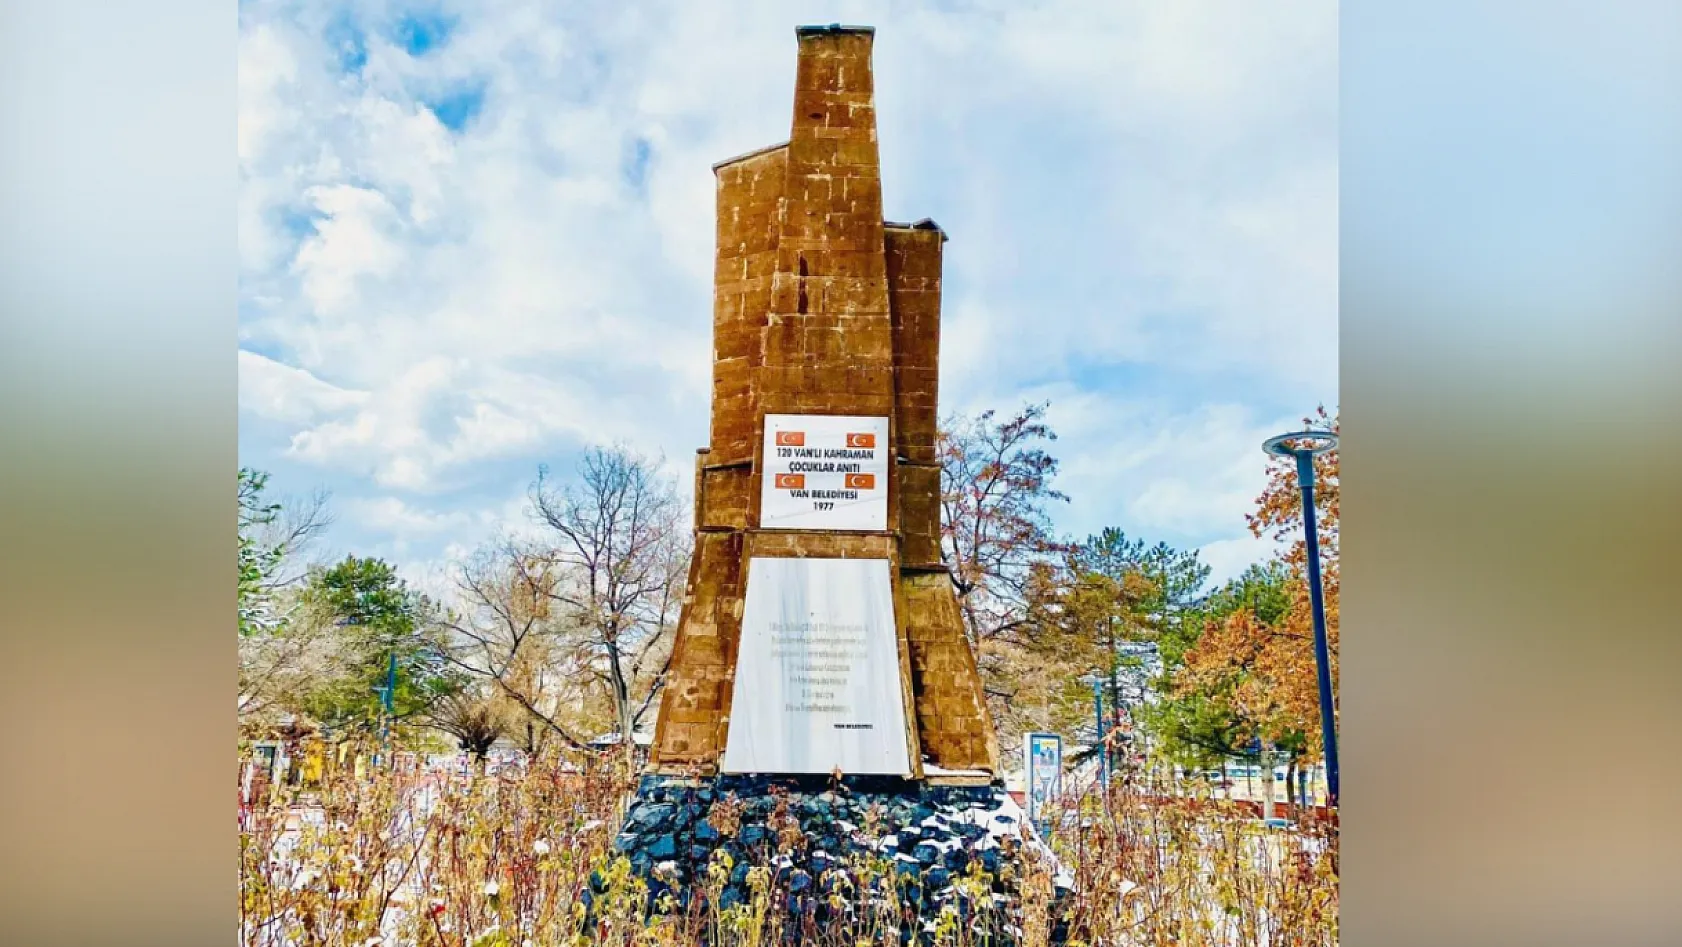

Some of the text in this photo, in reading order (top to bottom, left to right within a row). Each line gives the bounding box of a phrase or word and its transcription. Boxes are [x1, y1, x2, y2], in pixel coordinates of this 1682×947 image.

[777, 448, 874, 460] 120 VAN'LI KAHRAMAN
[788, 461, 860, 473] ÇOCUKLAR ANITI
[790, 489, 858, 500] VAN BELEDİYESİ
[813, 502, 834, 511] 1977
